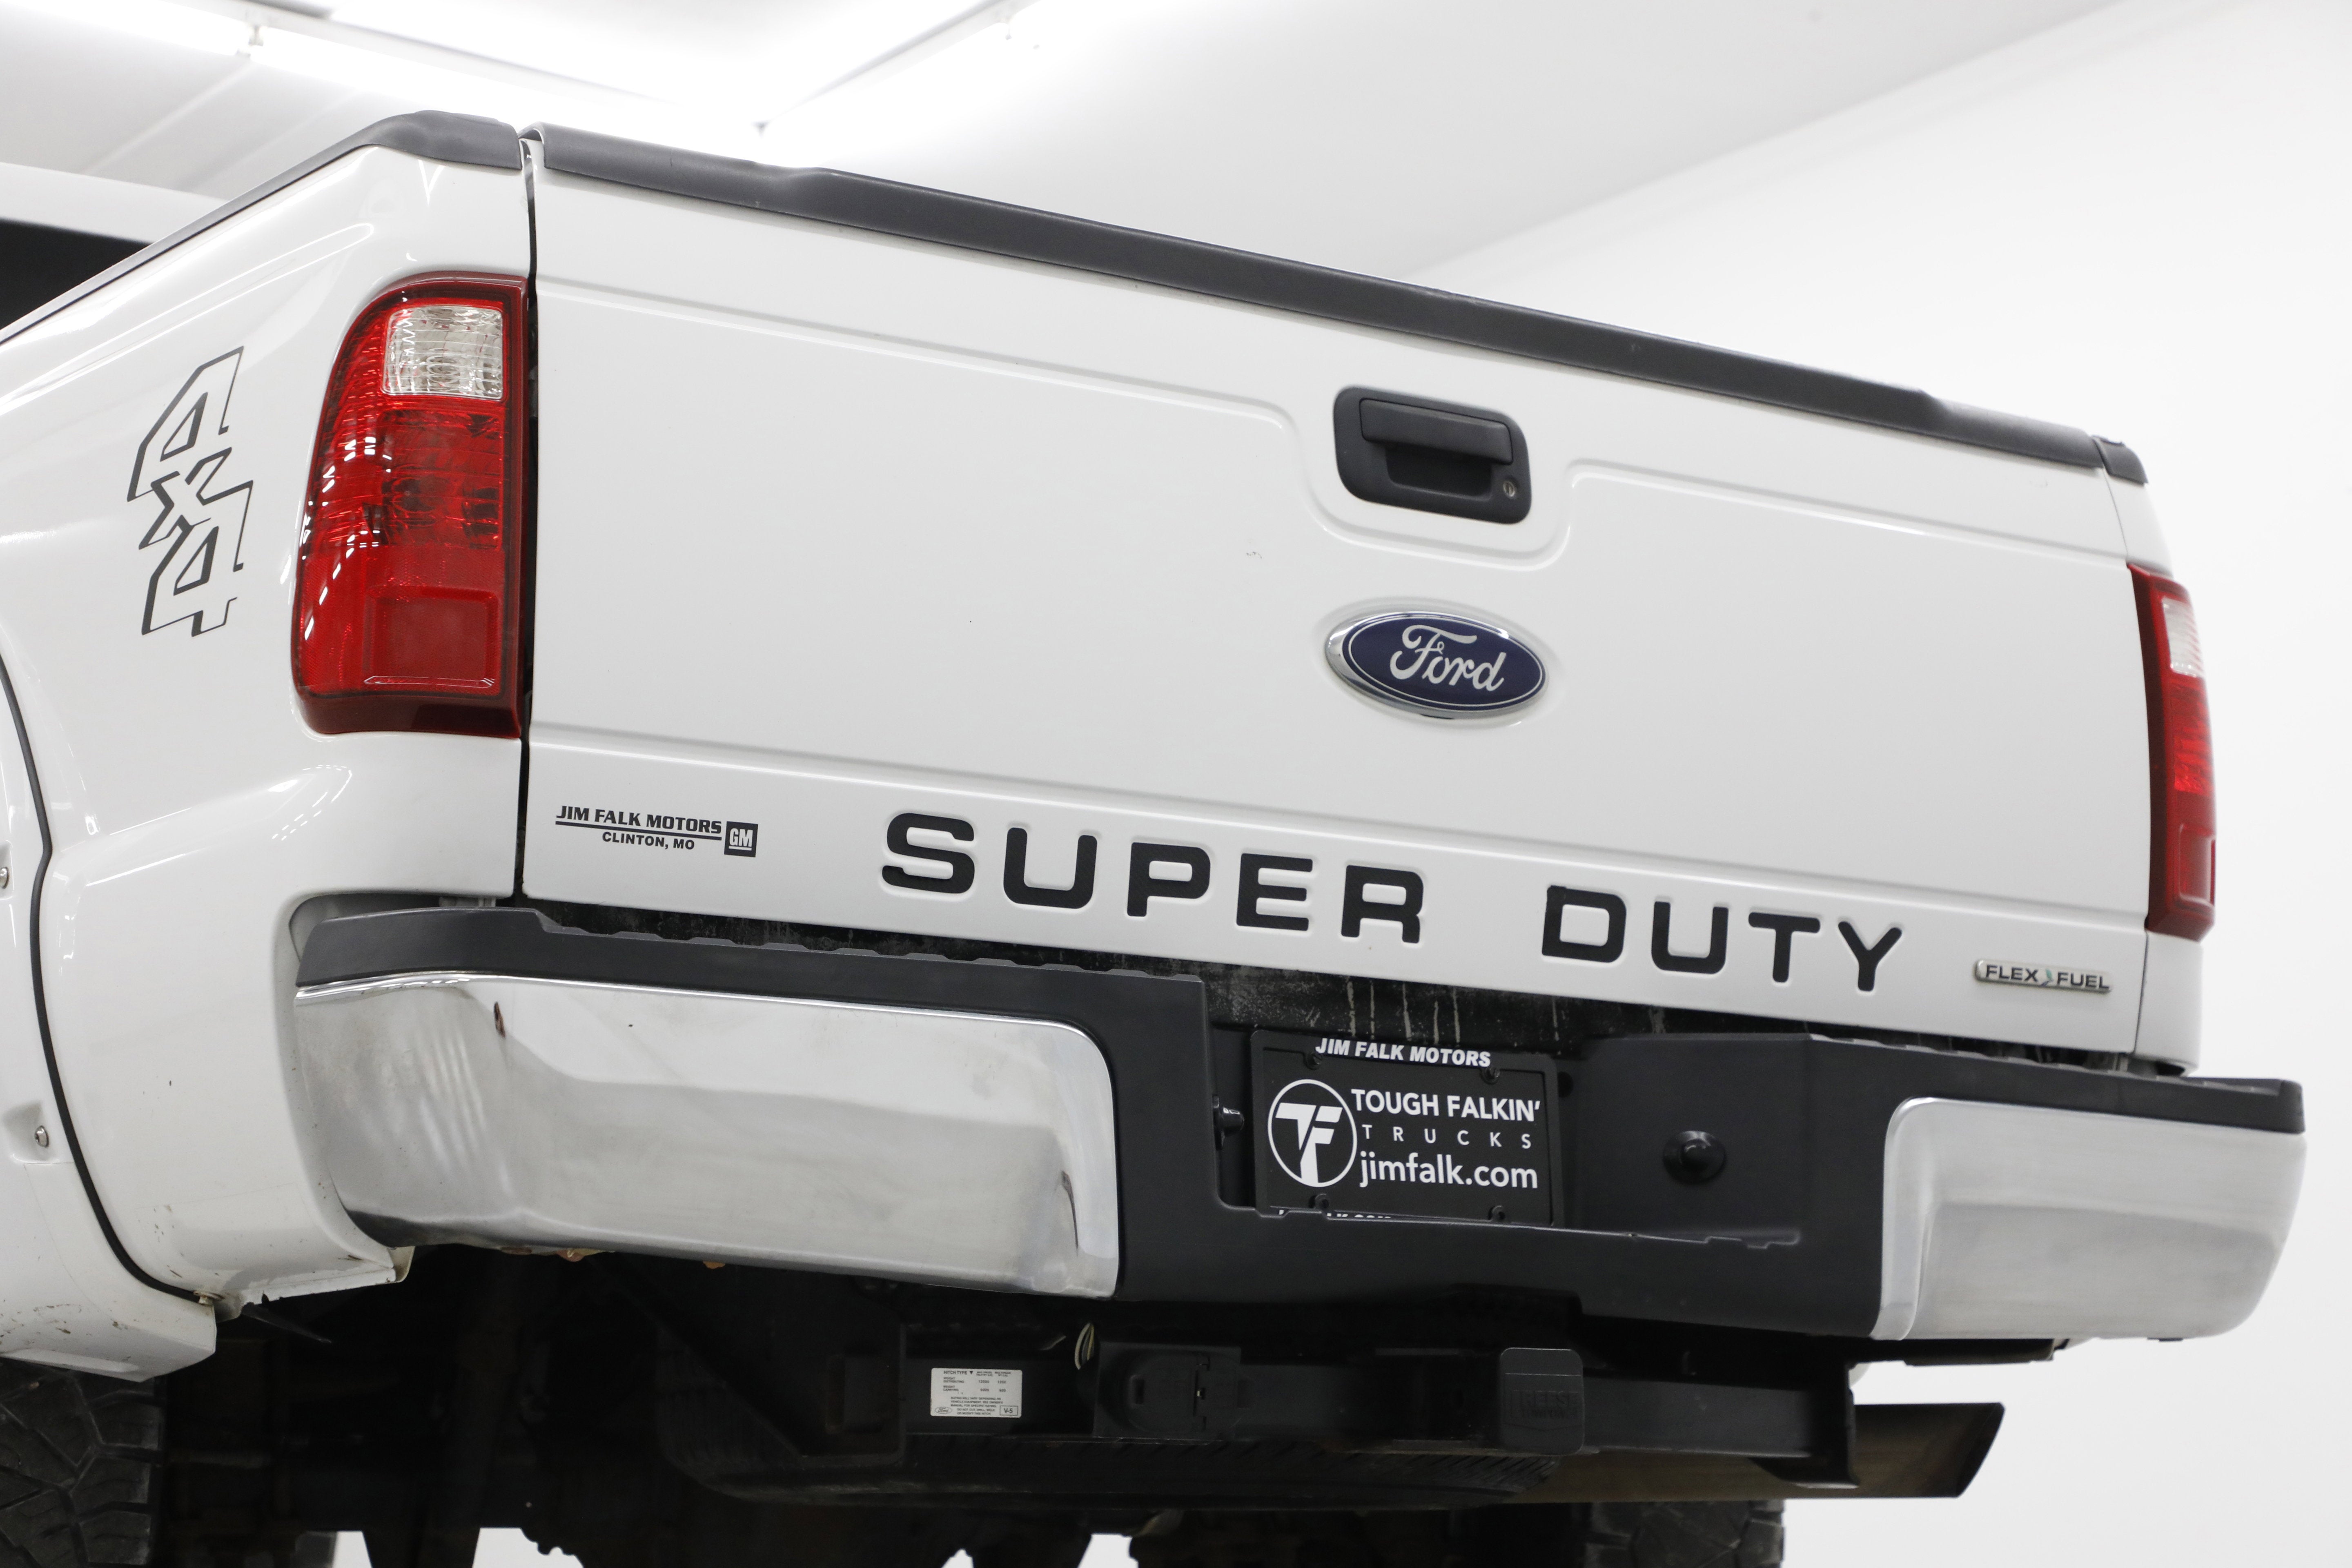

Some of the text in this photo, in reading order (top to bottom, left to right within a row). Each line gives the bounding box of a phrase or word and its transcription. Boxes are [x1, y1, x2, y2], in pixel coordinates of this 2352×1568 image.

[1390, 624, 1507, 692] Ford
[556, 806, 722, 834] JIM FALK MOTORS
[602, 832, 695, 850] CLINTON, MO
[729, 828, 753, 847] GM
[882, 813, 1902, 992] SUPER DUTY
[1986, 964, 2110, 989] FLEX FUEL
[1315, 1038, 1491, 1067] JIM FALK MOTORS
[1351, 1089, 1540, 1122] TOUGH FALKIN'
[1362, 1124, 1531, 1149] TRUCKS
[1359, 1151, 1538, 1189] jimfalk.com
